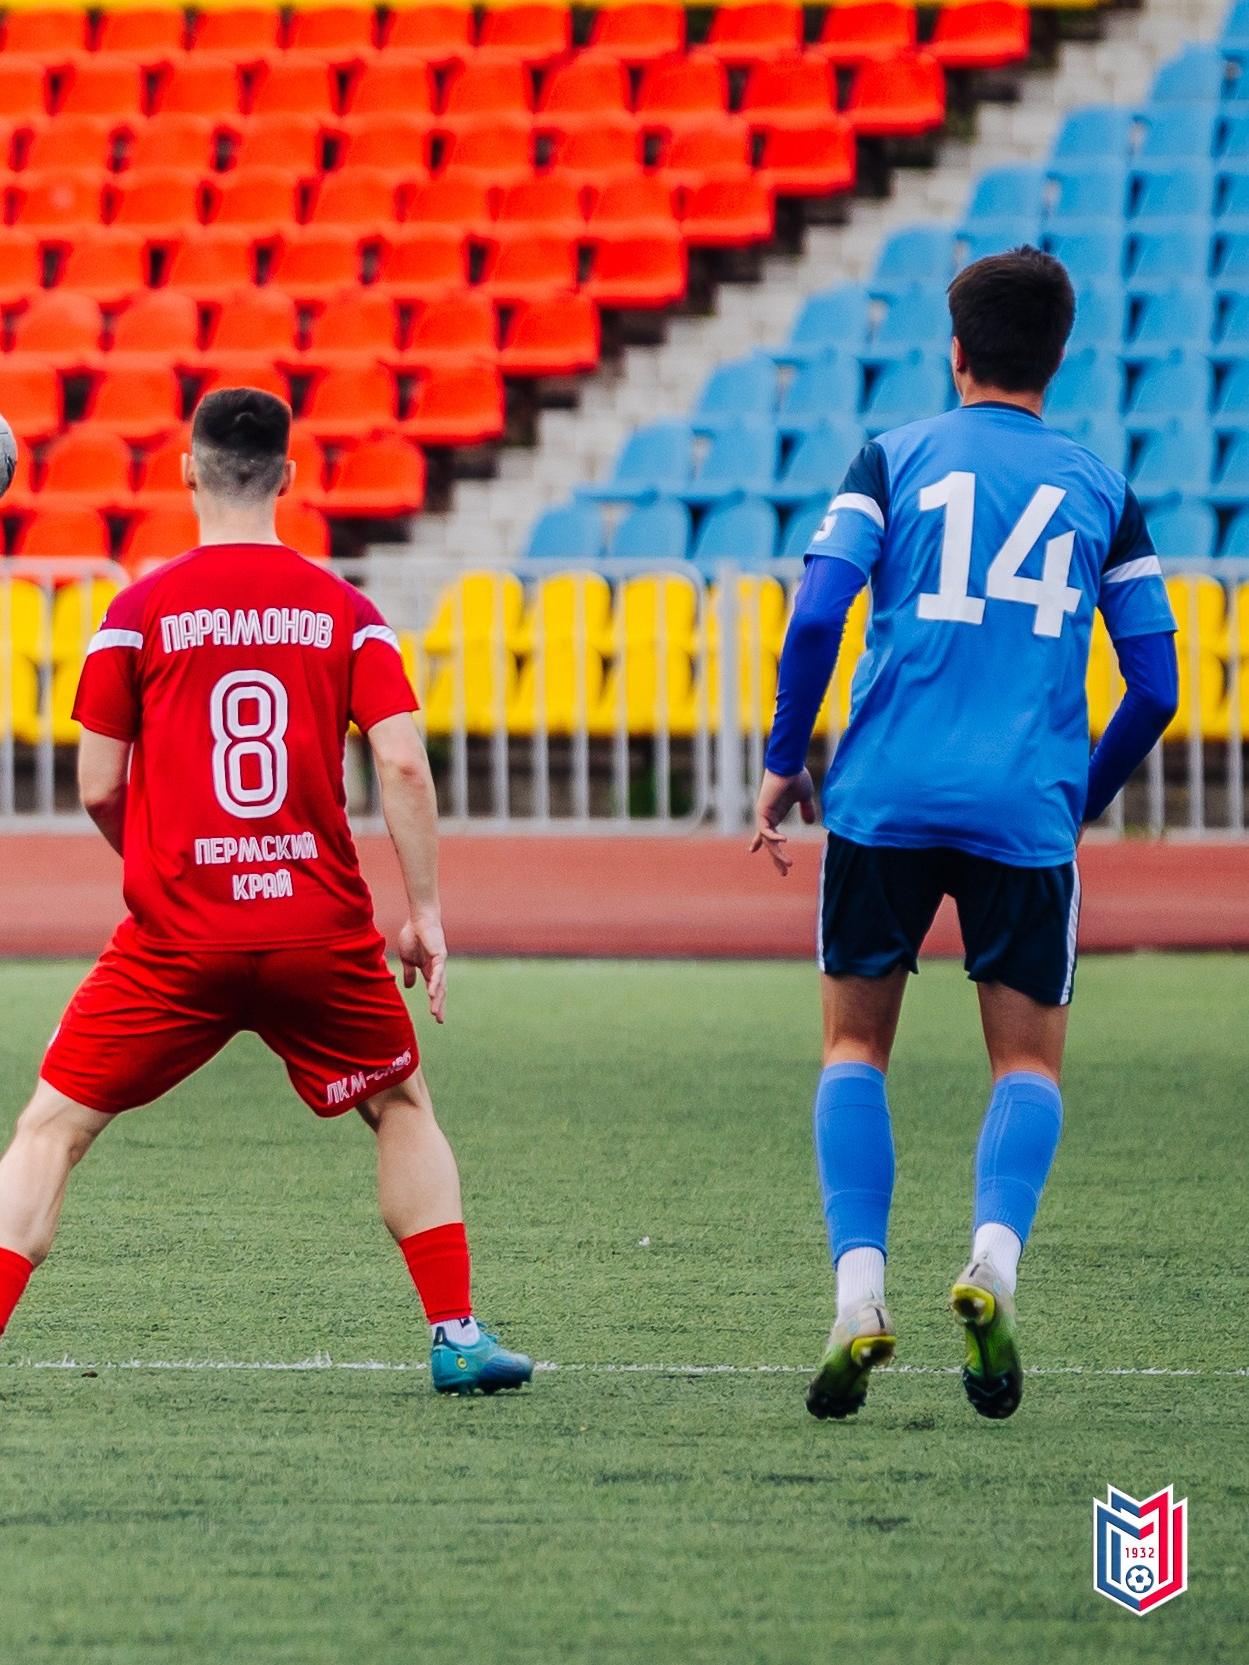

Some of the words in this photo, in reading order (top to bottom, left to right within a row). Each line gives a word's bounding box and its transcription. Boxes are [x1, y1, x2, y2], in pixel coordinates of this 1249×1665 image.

[916, 471, 1082, 638] 14
[160, 608, 333, 654] ПАРАМОНОВ
[209, 669, 288, 818] 8
[194, 832, 318, 865] ПЕРМСКИЙ
[232, 868, 293, 900] КРАЙ
